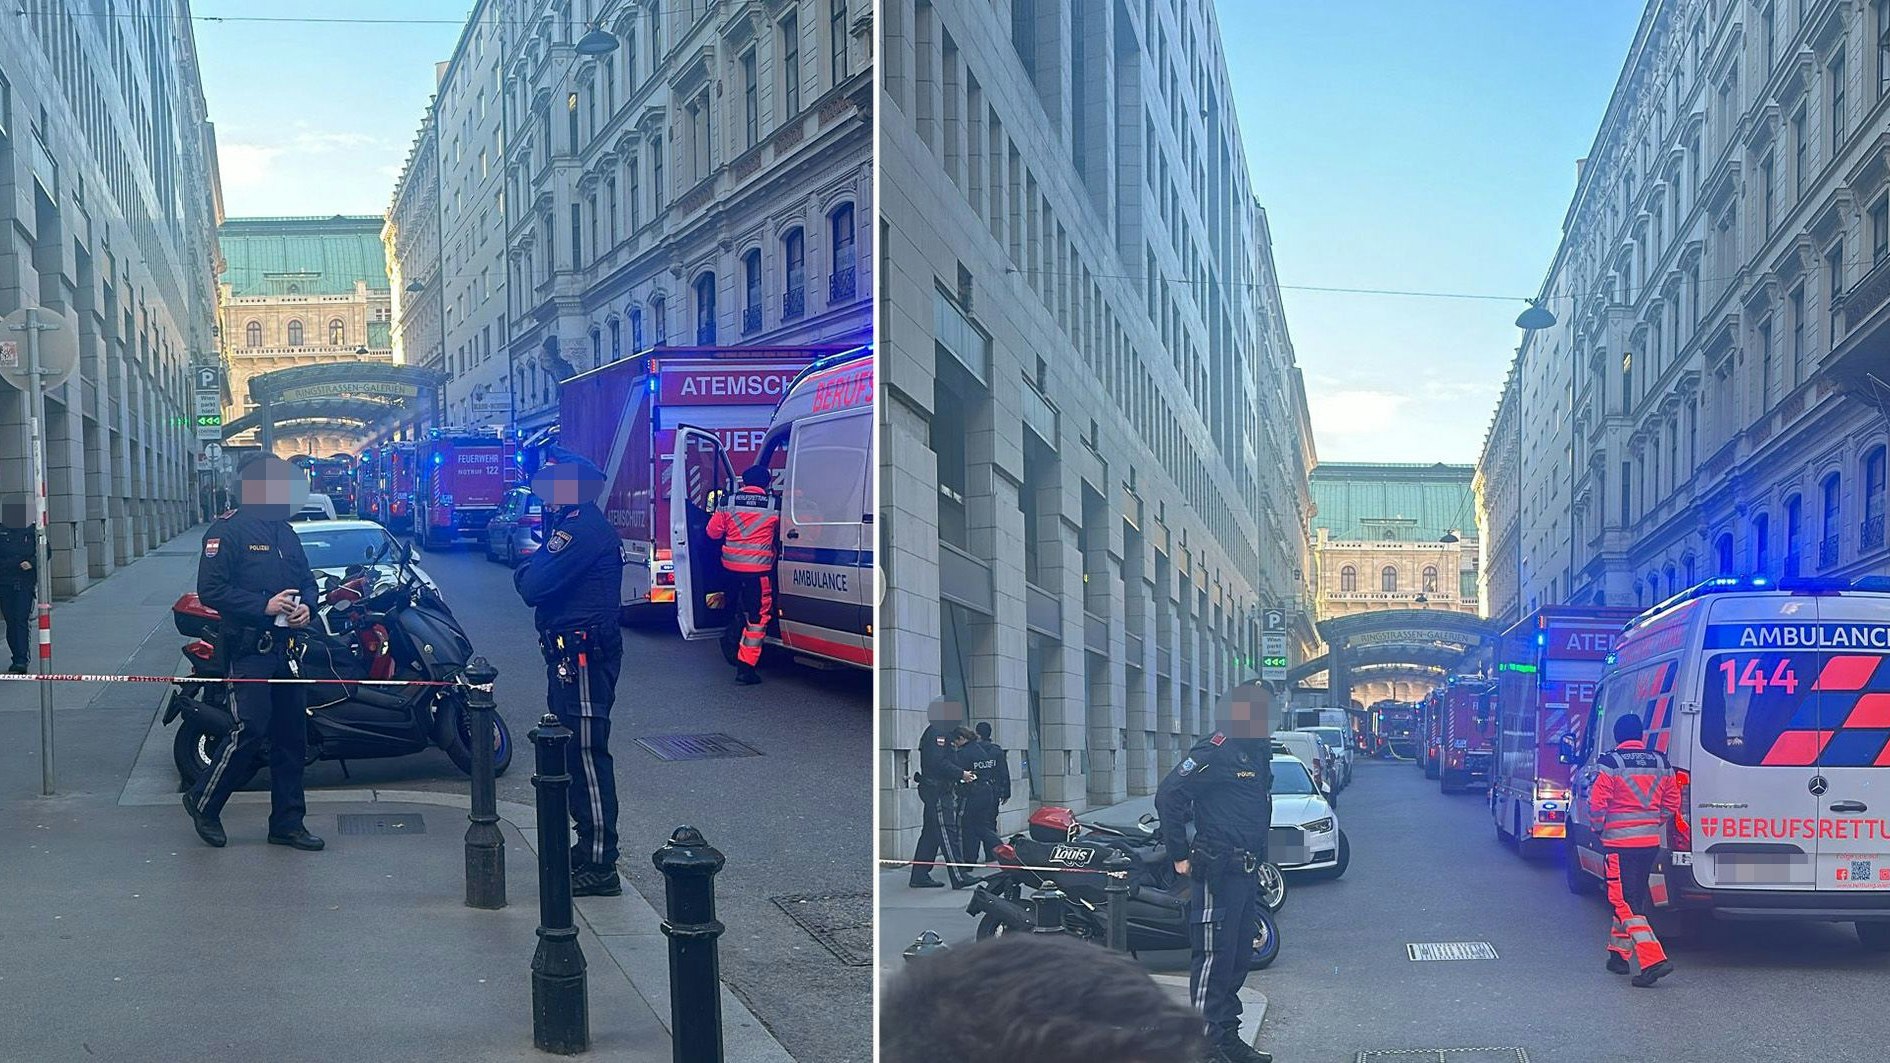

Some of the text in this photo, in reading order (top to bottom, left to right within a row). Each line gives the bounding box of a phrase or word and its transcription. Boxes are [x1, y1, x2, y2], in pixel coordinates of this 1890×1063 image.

[202, 372, 214, 387] P
[295, 382, 406, 398] RINGSTRASSEN-GALERIEN
[457, 454, 499, 464] FEUERWEHR
[486, 466, 499, 475] 122
[793, 568, 848, 592] AMBULANCE
[1269, 613, 1281, 628] P
[1360, 630, 1469, 643] RINGSTRASSEN-GALERIEN
[1739, 626, 1890, 647] AMBULANC
[1719, 658, 1799, 695] 144
[973, 760, 997, 770] POLIZEI
